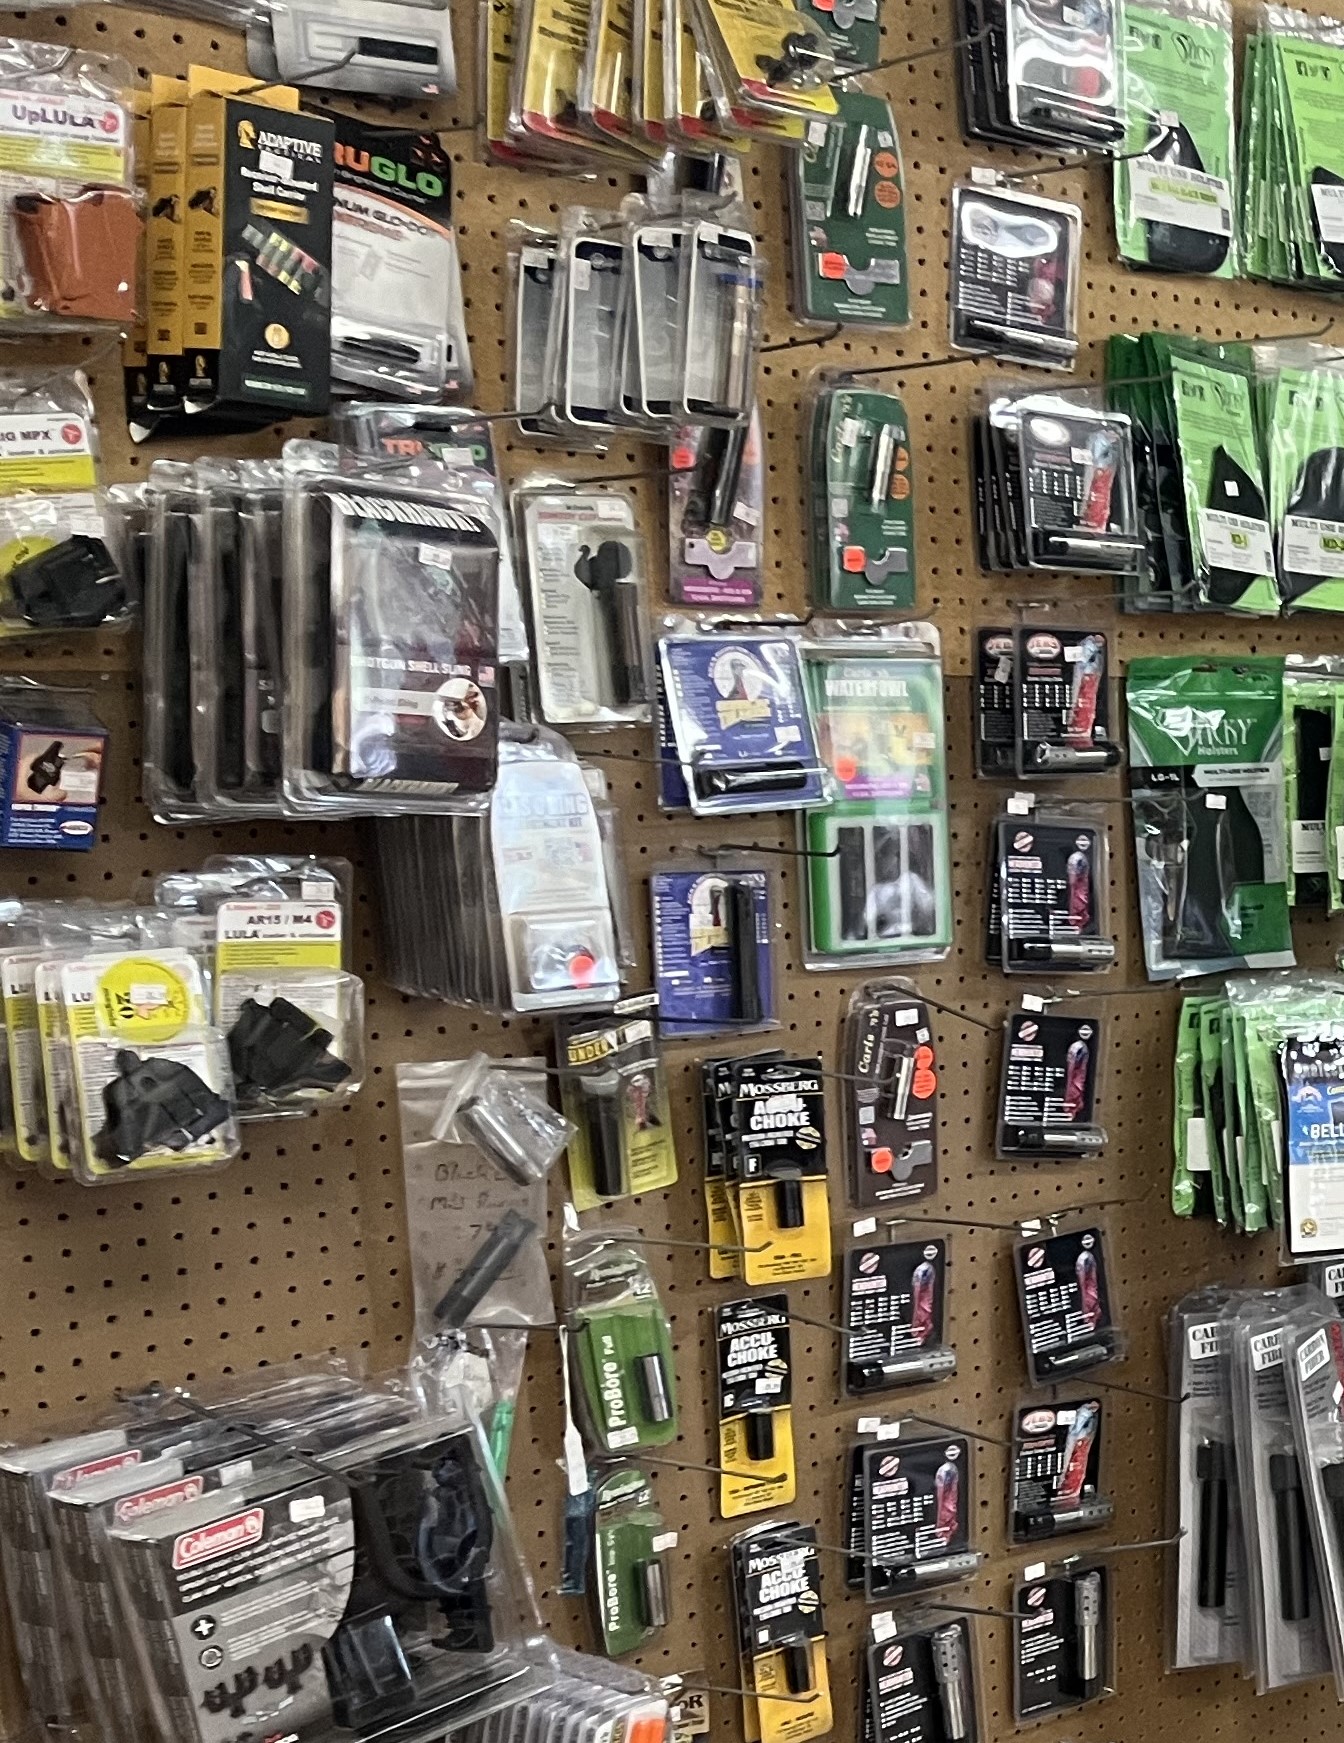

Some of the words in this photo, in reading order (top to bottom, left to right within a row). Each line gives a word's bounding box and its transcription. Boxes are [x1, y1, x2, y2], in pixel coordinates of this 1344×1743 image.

[12, 104, 97, 129] UpLULA
[258, 131, 323, 156] ADAPTIVE
[247, 914, 282, 926] AR15
[224, 929, 260, 940] LULA
[740, 1080, 818, 1098] MOSSBERG
[750, 1112, 810, 1131] CHOKE
[750, 1158, 757, 1172] F
[721, 1315, 786, 1336] MOSSBERG
[730, 1332, 776, 1352] ACCU-
[727, 1345, 778, 1368] CHOKE
[602, 1364, 626, 1428] ProBore
[179, 1521, 246, 1559] Coleman
[759, 1576, 810, 1603] CHOKE
